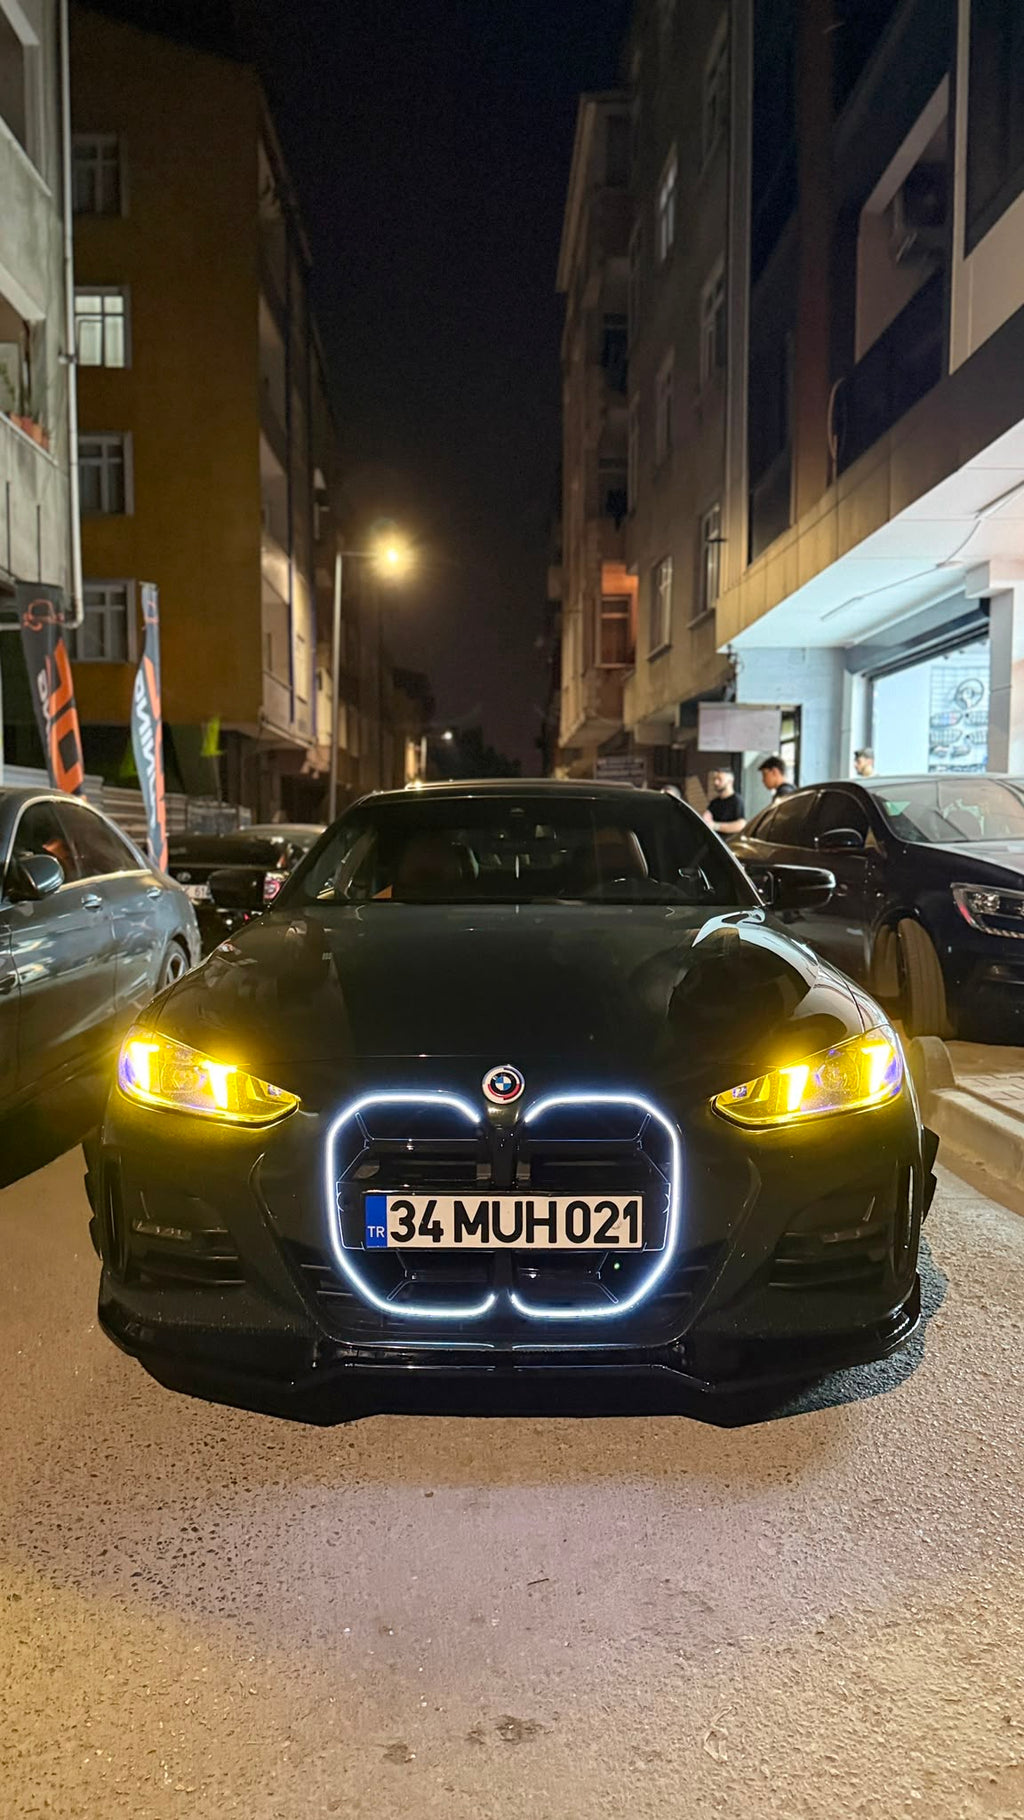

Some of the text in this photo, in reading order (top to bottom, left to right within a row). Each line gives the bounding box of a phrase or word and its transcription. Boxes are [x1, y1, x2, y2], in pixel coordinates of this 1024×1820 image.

[367, 1226, 385, 1238] TR
[390, 1200, 638, 1243] 34 MUH 021
